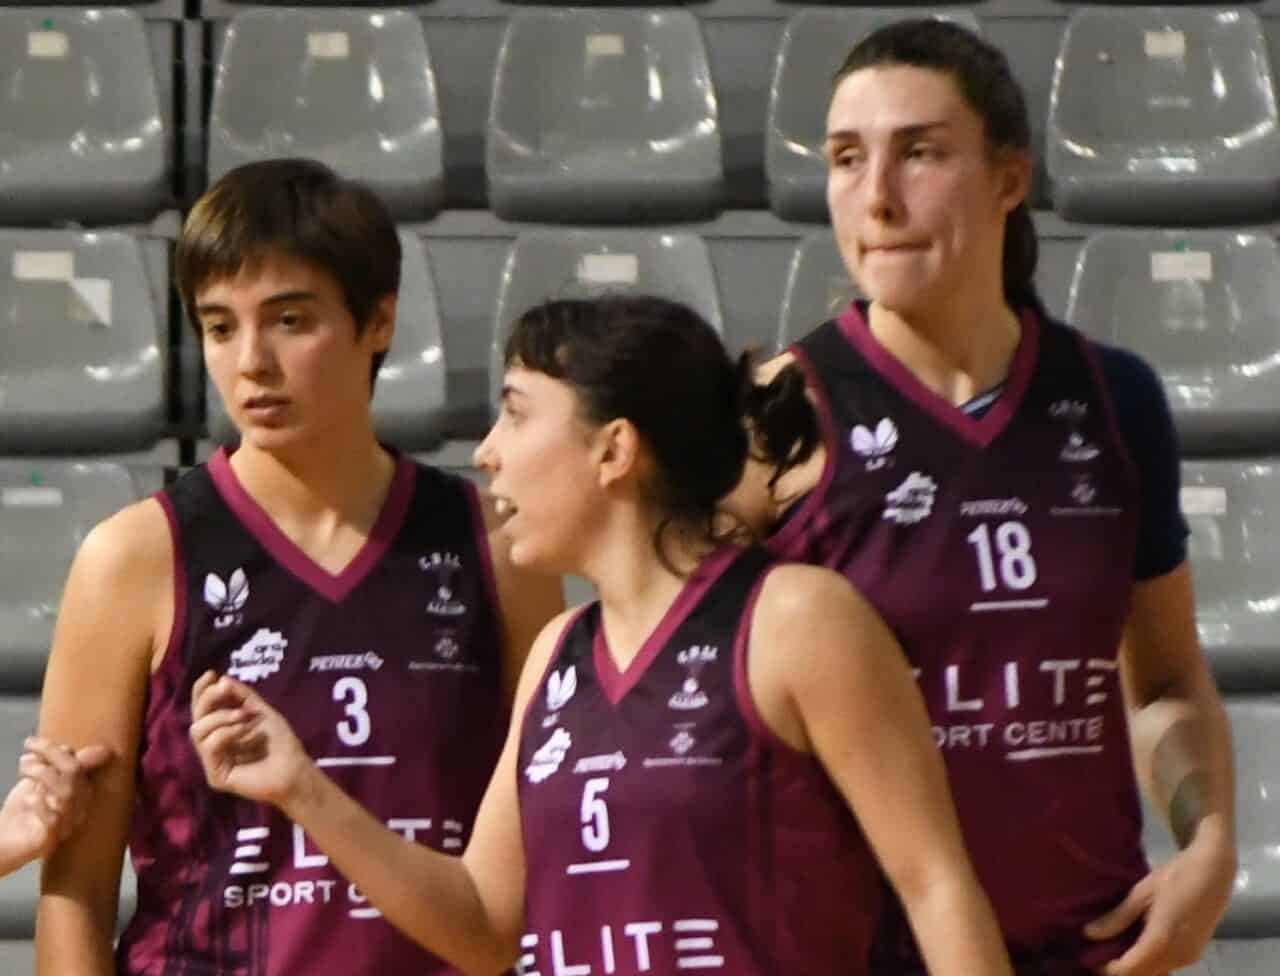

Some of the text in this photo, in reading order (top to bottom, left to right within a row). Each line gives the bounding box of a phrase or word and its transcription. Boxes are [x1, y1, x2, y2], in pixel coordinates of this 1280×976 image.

[968, 520, 1037, 592] 18
[332, 676, 371, 747] 3
[912, 658, 1120, 713] LITE
[932, 715, 1105, 749] ORT CENTE
[581, 777, 610, 852] 5
[223, 880, 337, 909] SPORT
